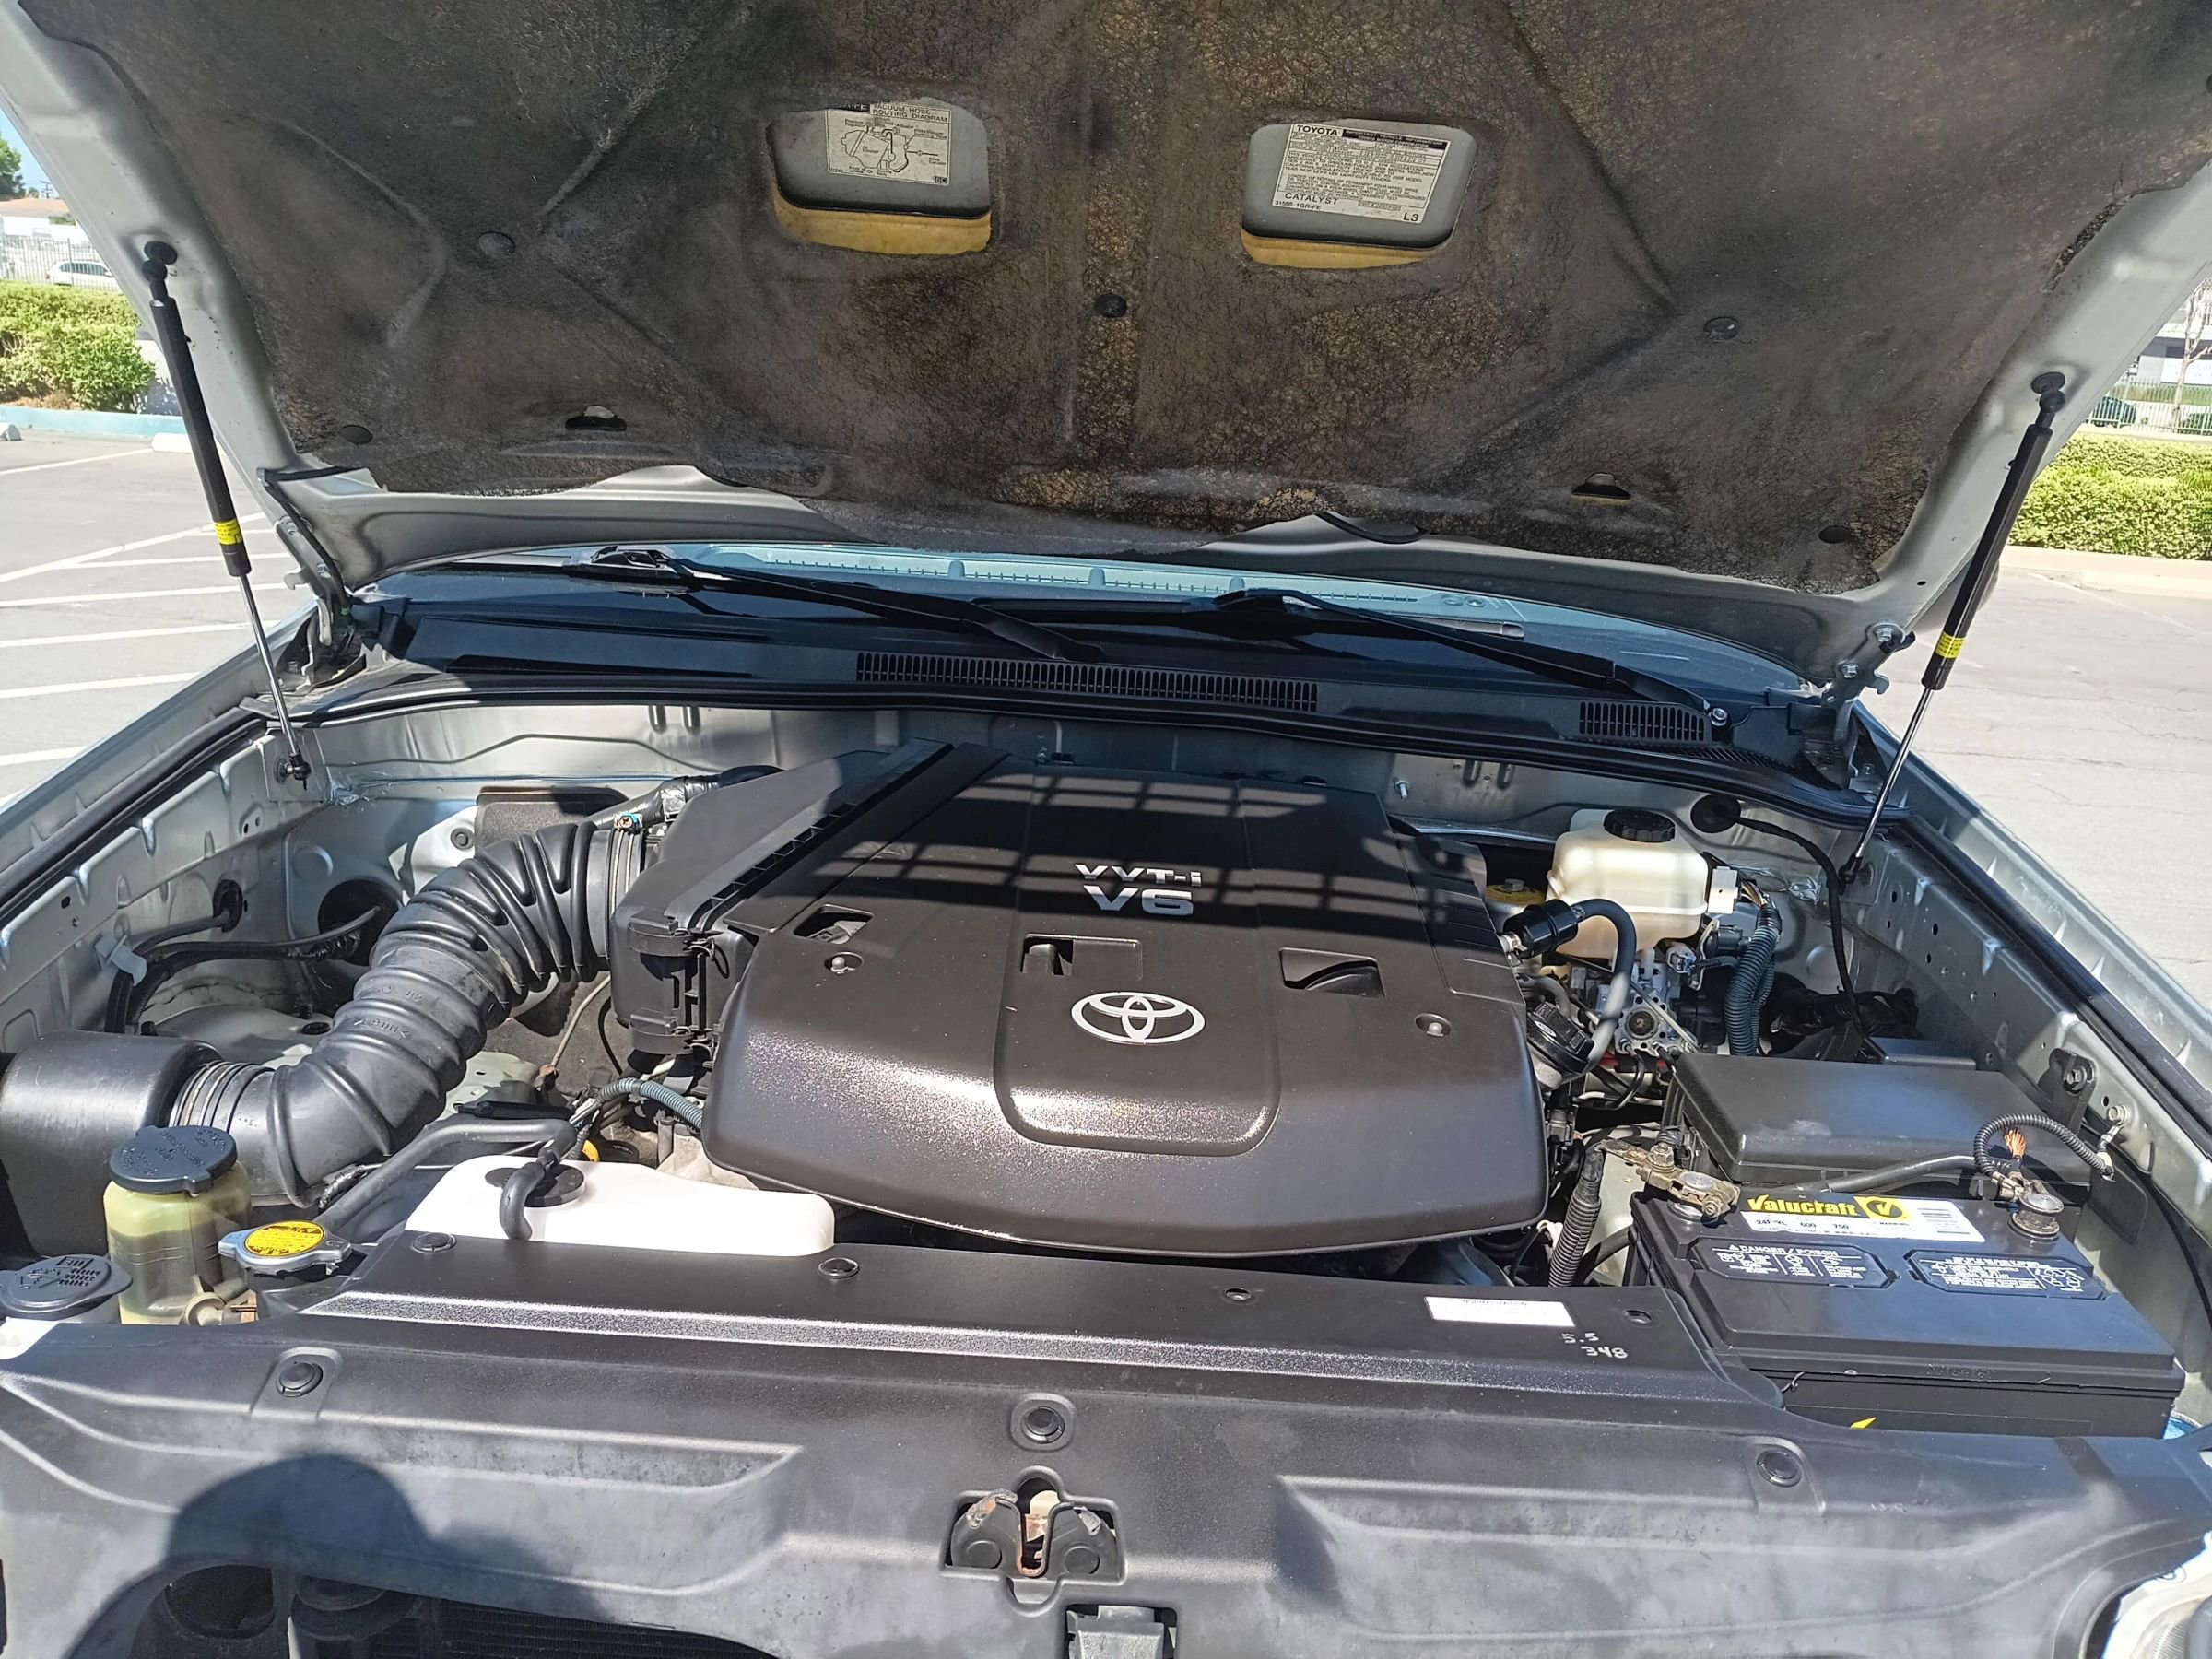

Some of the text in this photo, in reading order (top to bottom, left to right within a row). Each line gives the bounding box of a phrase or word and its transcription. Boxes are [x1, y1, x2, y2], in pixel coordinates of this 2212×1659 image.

[873, 110, 947, 123] ROUTING DIAGRAM
[909, 107, 931, 115] HOSE
[1296, 124, 1339, 135] TOYOTA
[1284, 192, 1339, 205] CATALYST
[1402, 211, 1420, 222] L3
[1075, 864, 1202, 887] VVT-i
[1083, 884, 1194, 916] V6
[1747, 1194, 1858, 1216] Valucraft
[1739, 1245, 1785, 1254] DANGER
[1796, 1248, 1840, 1257] POISON
[1580, 1346, 1629, 1359] 348
